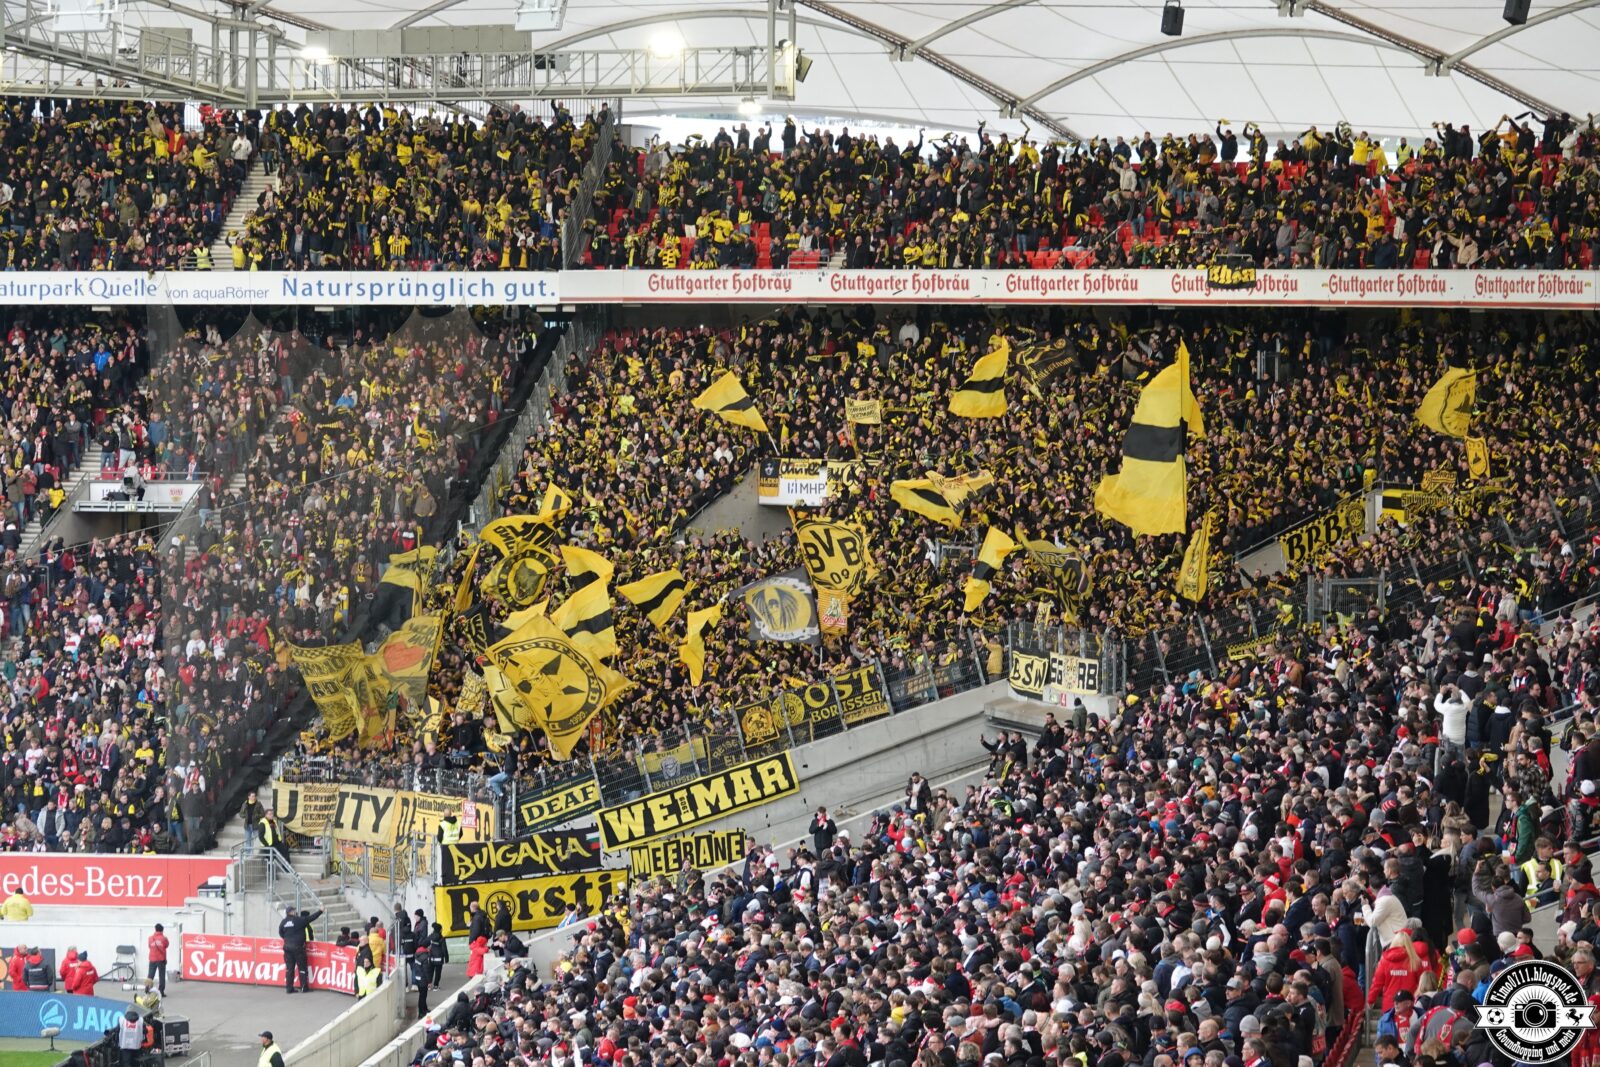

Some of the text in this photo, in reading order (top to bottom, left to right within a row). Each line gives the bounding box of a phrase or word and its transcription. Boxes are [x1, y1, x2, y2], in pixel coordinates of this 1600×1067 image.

[165, 287, 189, 299] von
[192, 286, 270, 301] aquaRömer
[281, 277, 556, 302] Natursprünglich gut.
[647, 272, 729, 295] Stuttgarter
[830, 272, 970, 295] Stuttgarter Hofbräu
[1005, 272, 1139, 296] Stuttgarter Hofbräu
[1328, 273, 1447, 298] Stuttgarter Hofbräu
[1474, 273, 1584, 299] Stuttgarter Hofbräu
[799, 482, 826, 495] MHP
[803, 528, 861, 574] BVB
[830, 568, 850, 585] 09
[804, 664, 875, 708] OST
[525, 783, 596, 823] DEAF
[604, 758, 791, 843] WEIMAR
[632, 833, 745, 877] MEERANE
[0, 865, 163, 898] edes-Benz
